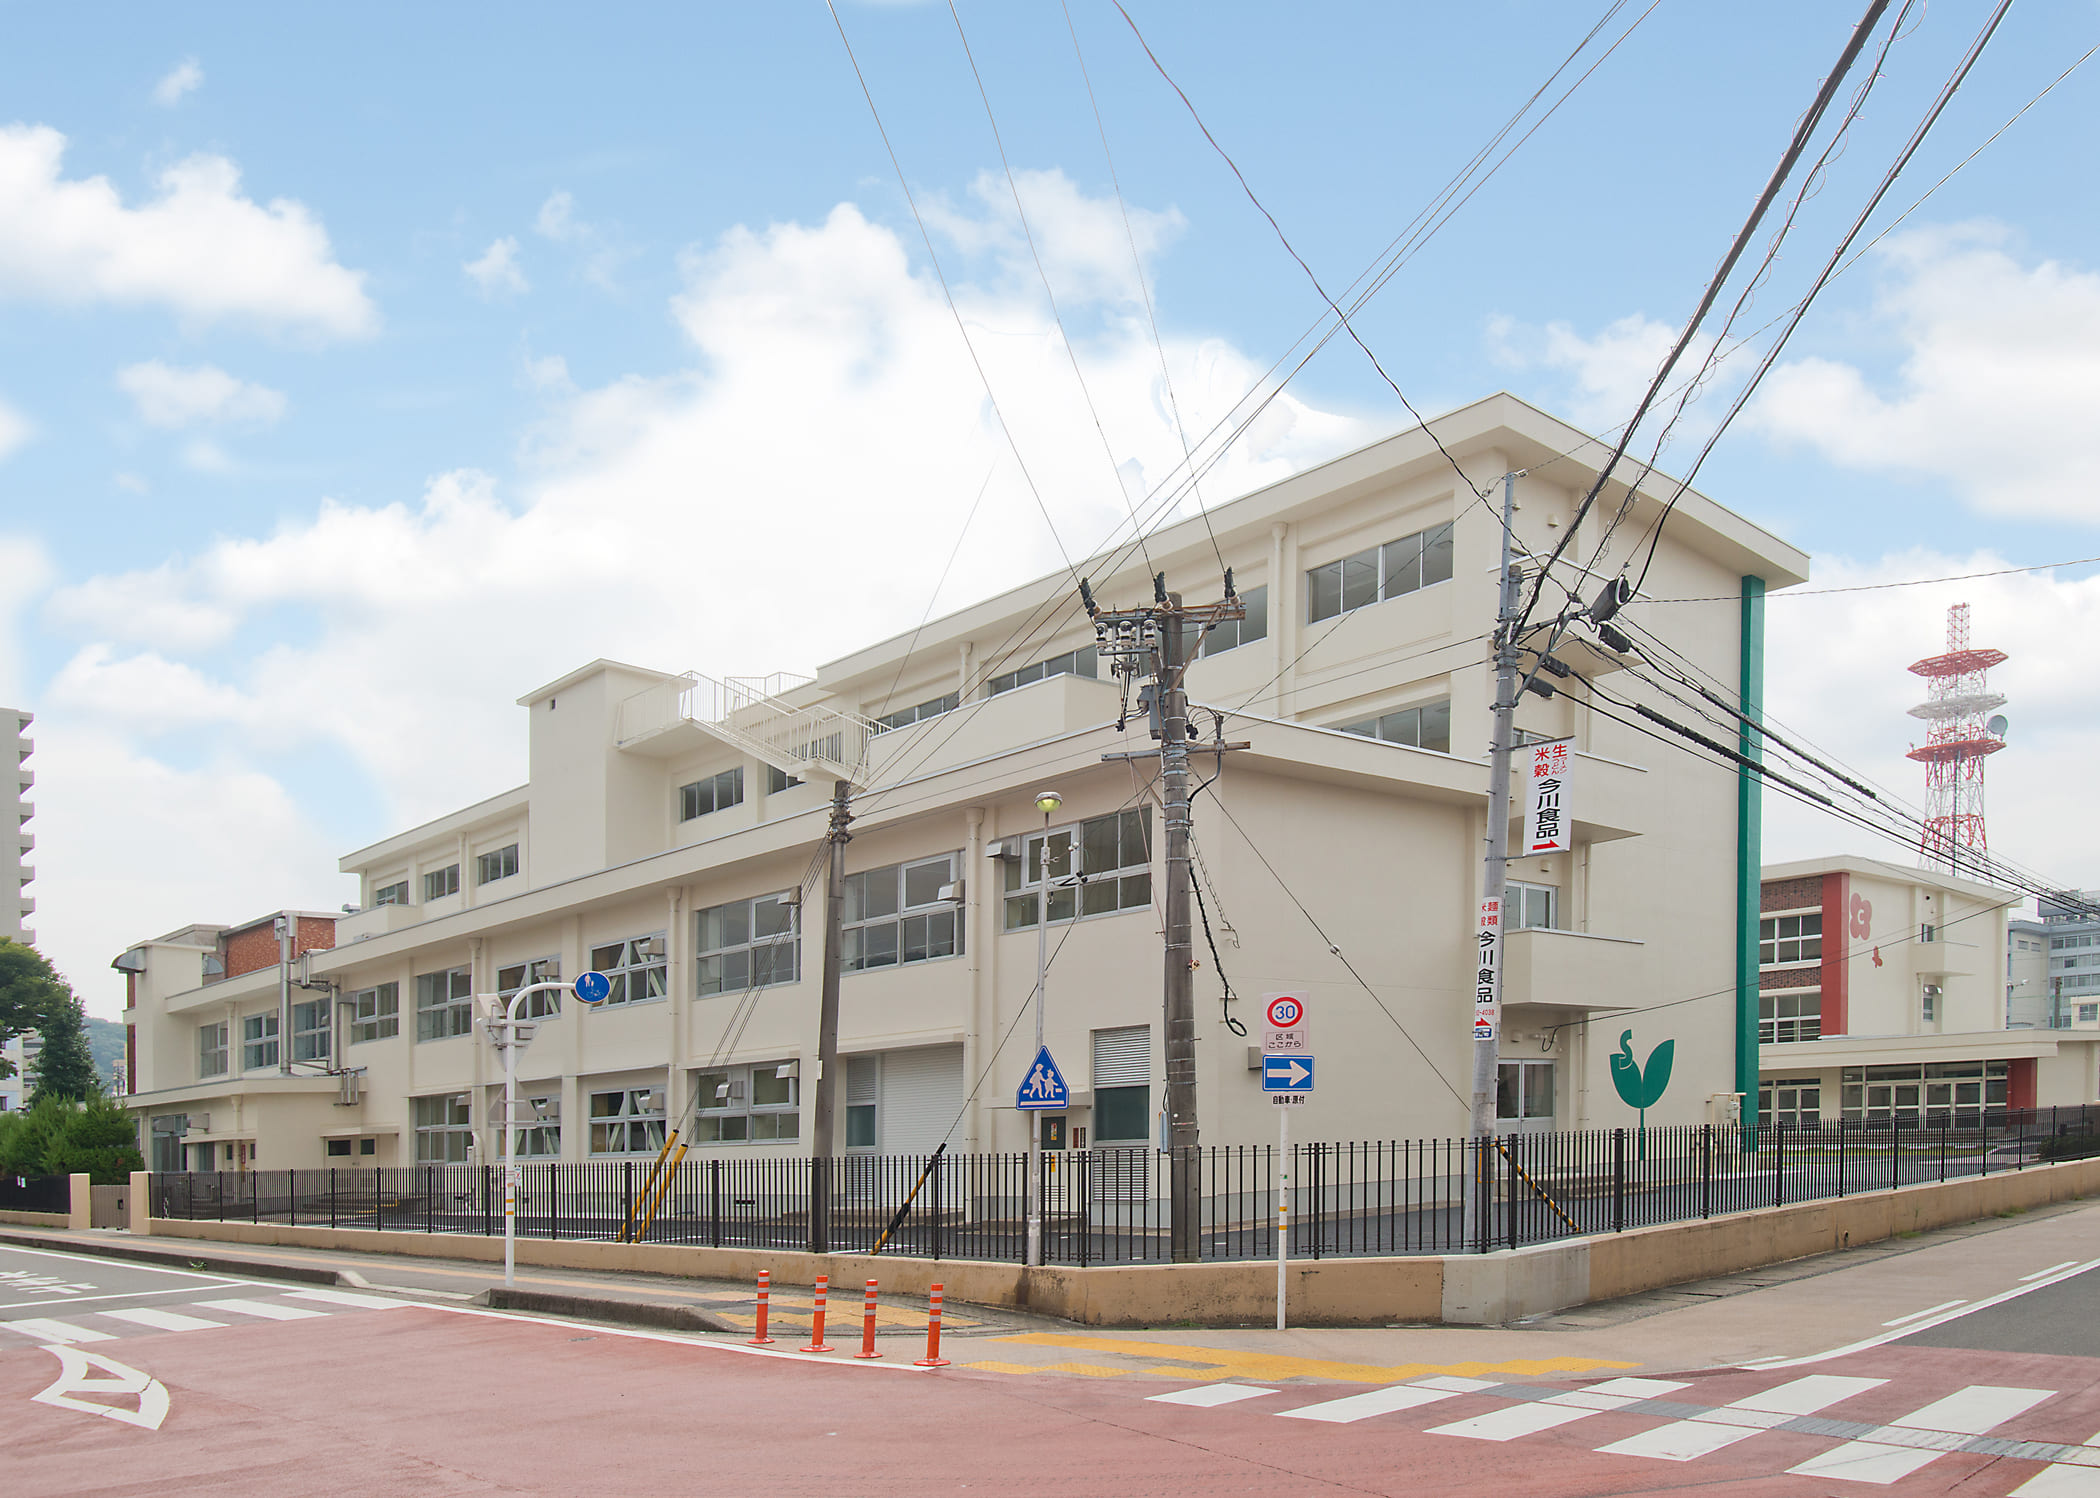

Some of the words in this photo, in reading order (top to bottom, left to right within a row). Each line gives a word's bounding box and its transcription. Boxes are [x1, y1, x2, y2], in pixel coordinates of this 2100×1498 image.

[1536, 778, 1561, 839] 今川食品
[1477, 930, 1496, 1003] 今川食品
[1275, 1005, 1296, 1020] 30
[1275, 1033, 1294, 1041] 区域
[1268, 1041, 1302, 1049] ここから
